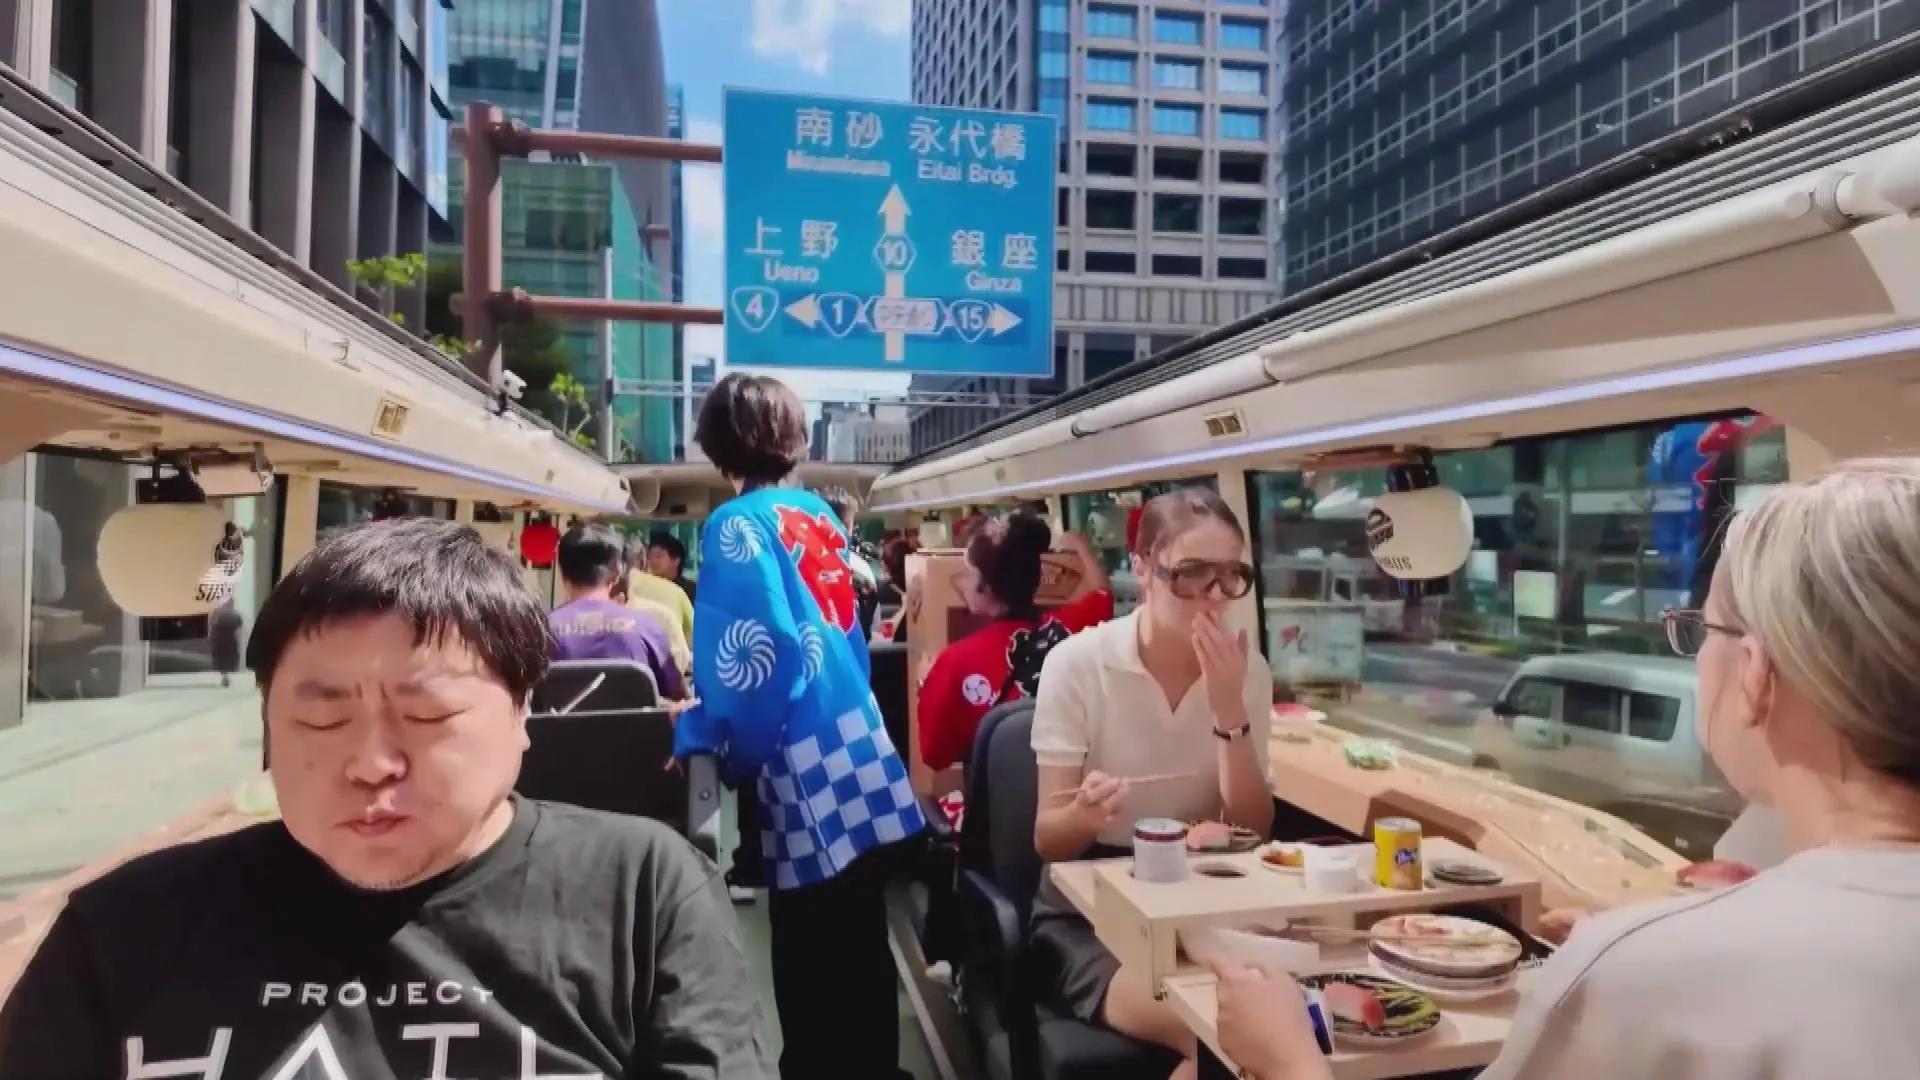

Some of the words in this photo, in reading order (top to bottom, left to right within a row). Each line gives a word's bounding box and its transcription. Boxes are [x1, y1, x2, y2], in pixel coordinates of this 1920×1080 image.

[796, 107, 883, 149] 南砂
[909, 116, 1026, 161] 永代橋
[743, 215, 839, 259] 上野
[951, 229, 1038, 270] 銀座
[882, 241, 908, 266] 10
[745, 293, 763, 319] 4
[832, 299, 843, 325] 1
[958, 304, 985, 331] 15
[261, 980, 494, 1008] PROJECT
